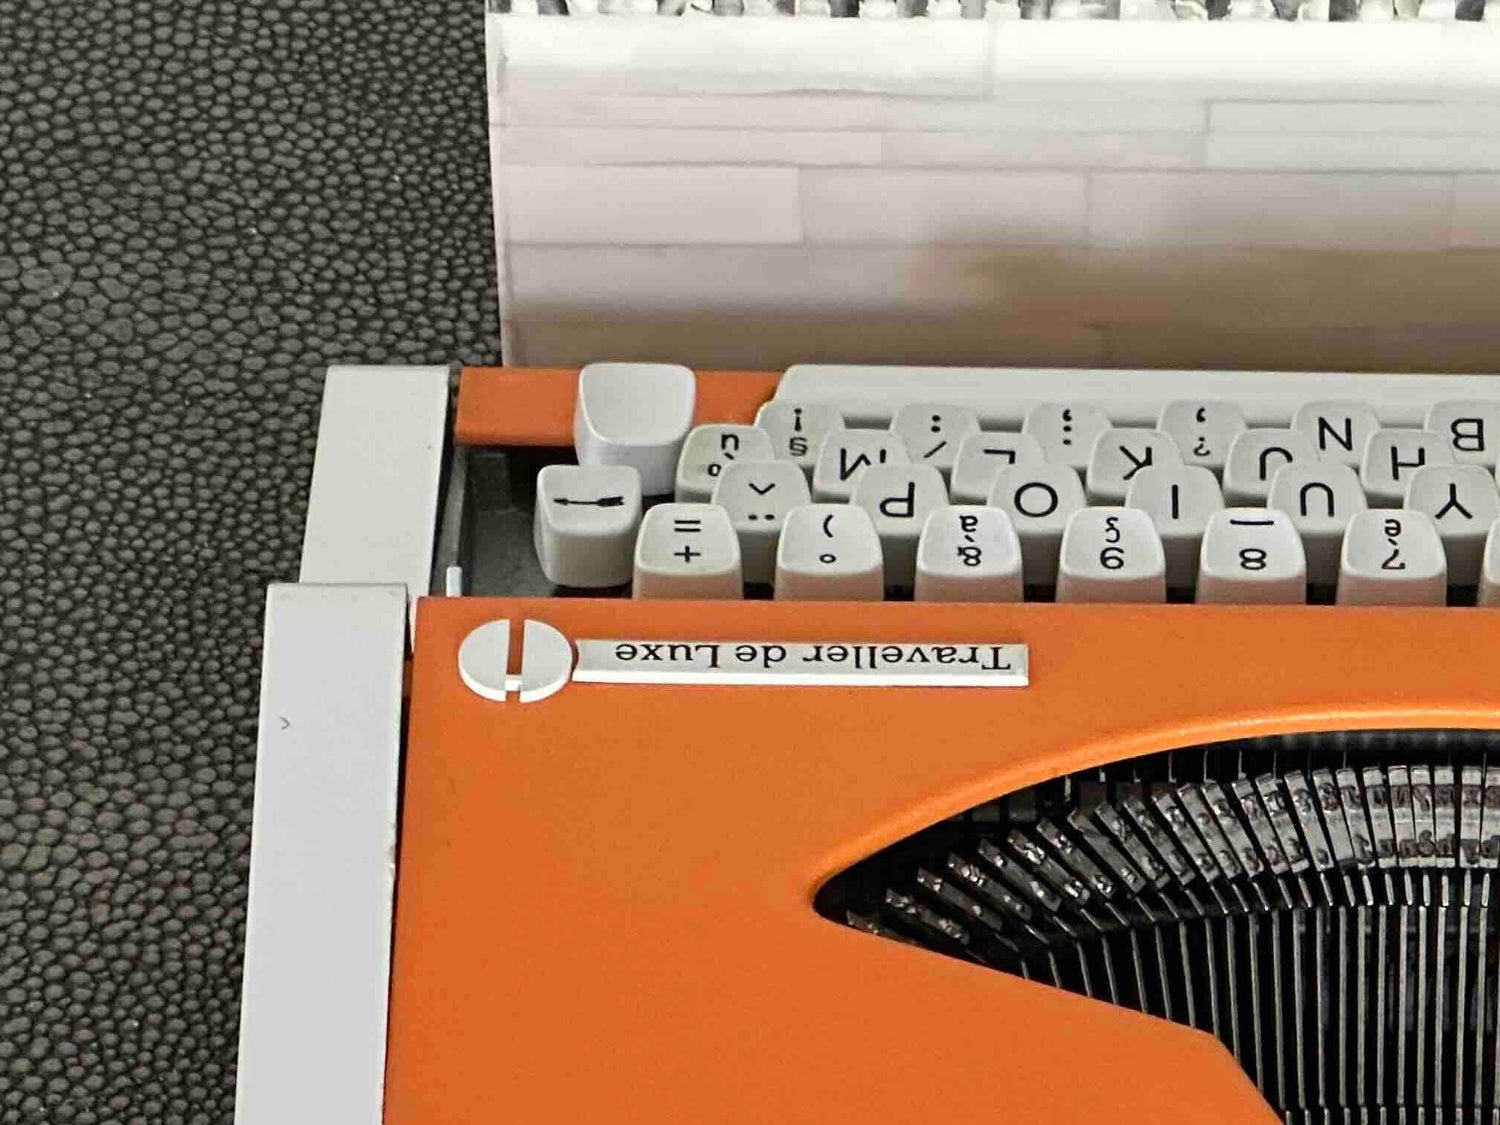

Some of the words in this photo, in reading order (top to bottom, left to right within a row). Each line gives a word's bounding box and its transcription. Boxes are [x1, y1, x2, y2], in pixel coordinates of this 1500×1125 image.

[1194, 437, 1210, 456] ?
[1319, 417, 1352, 451] N
[1451, 418, 1484, 451] B
[840, 448, 886, 481] M
[1120, 446, 1152, 480] K
[1260, 447, 1293, 480] J
[1391, 446, 1425, 480] H
[880, 482, 915, 518] P
[1014, 482, 1058, 517] O
[1172, 485, 1178, 519] I
[1300, 483, 1334, 517] U
[1435, 483, 1472, 519] Y
[960, 516, 978, 542] à
[1385, 519, 1401, 545] è
[1100, 547, 1124, 569] 9
[1239, 549, 1266, 570] 8
[1382, 549, 1405, 569] 7
[616, 644, 719, 668] Luxe
[736, 645, 786, 668] de
[803, 642, 1014, 670] Traveller
